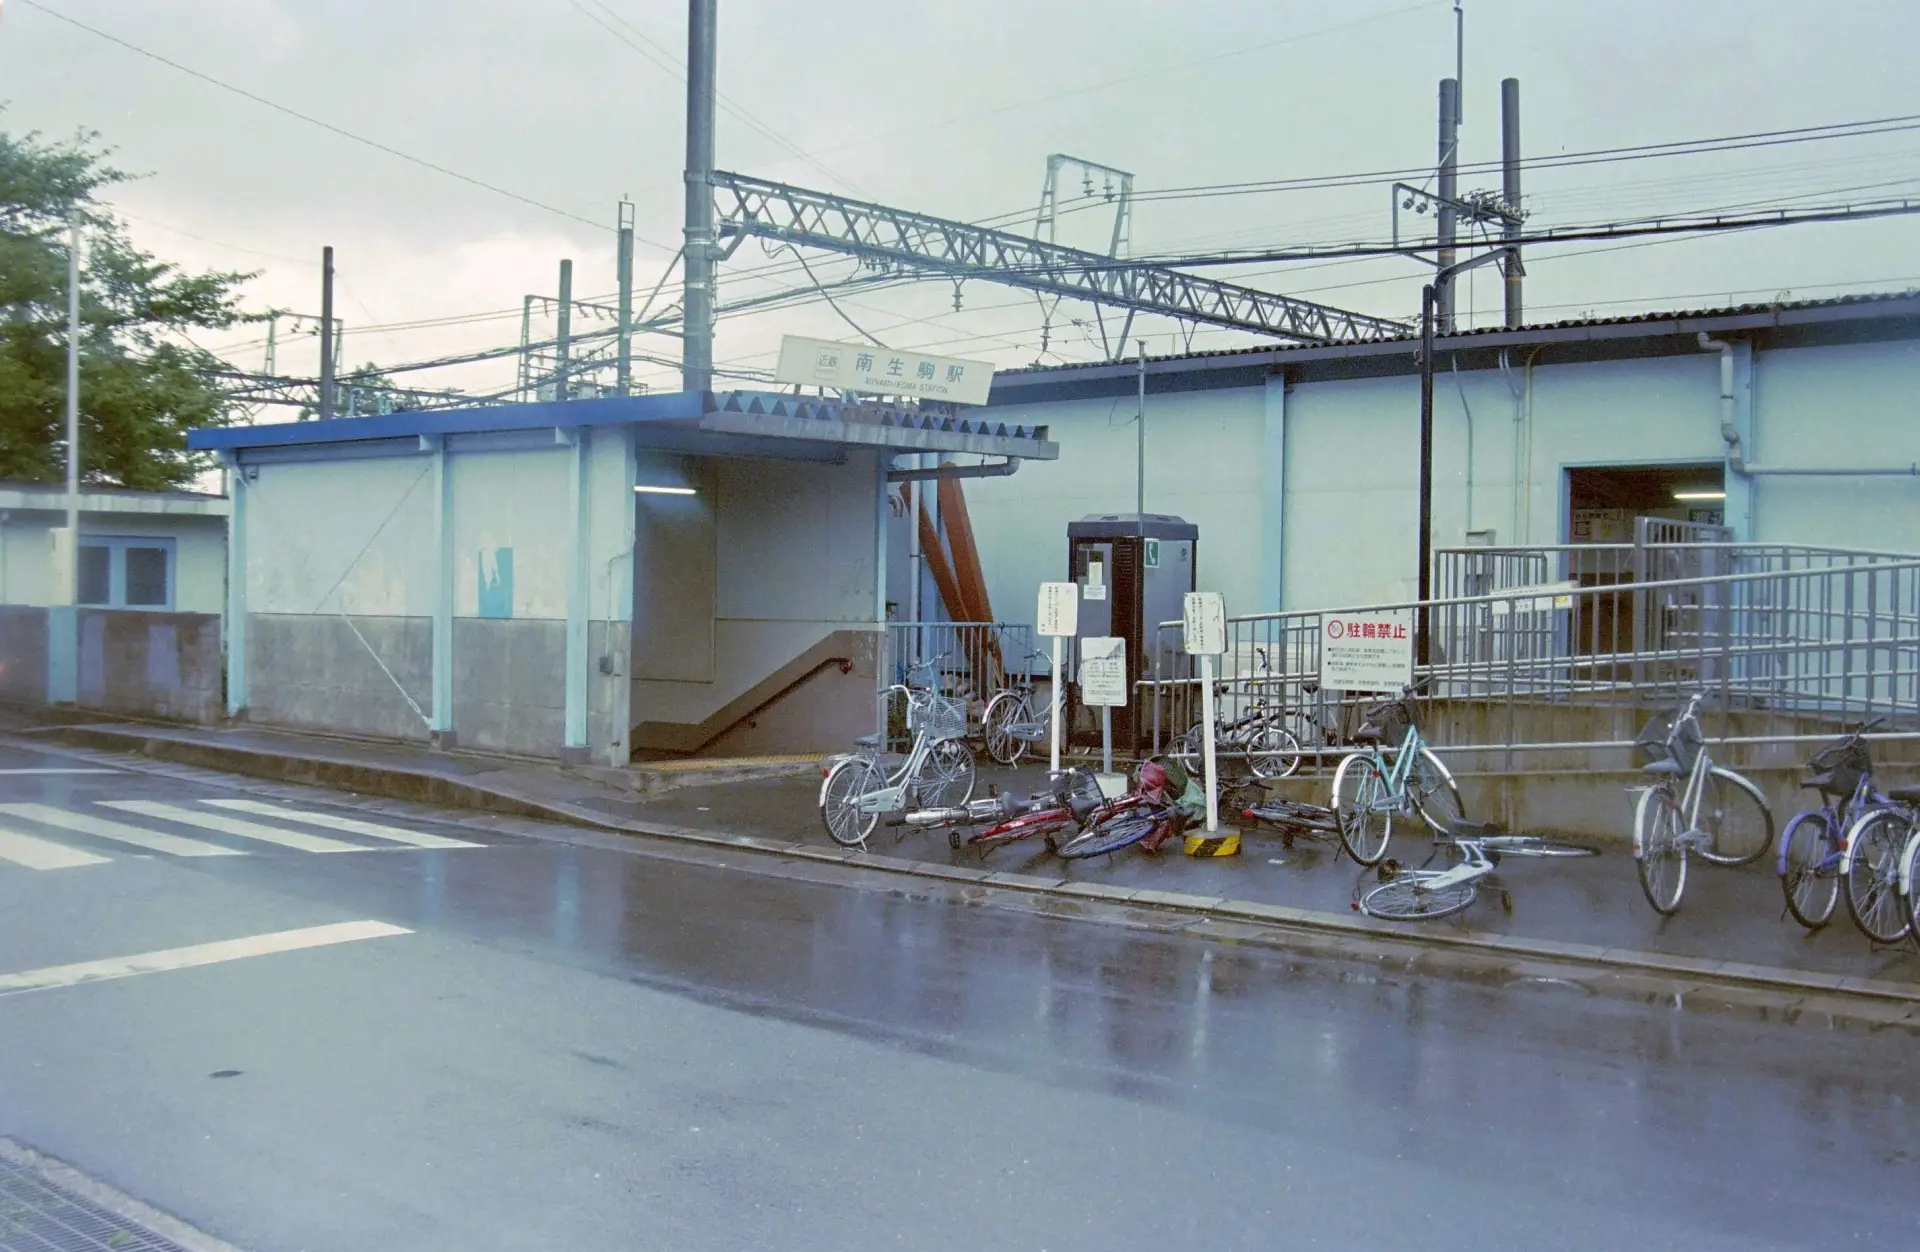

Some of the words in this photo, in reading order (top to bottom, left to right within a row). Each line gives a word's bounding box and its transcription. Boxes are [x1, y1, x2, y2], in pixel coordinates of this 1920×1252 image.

[855, 352, 965, 383] 南生駒駅
[919, 383, 948, 394] STATION
[1347, 622, 1407, 639] 駐輪禁止
